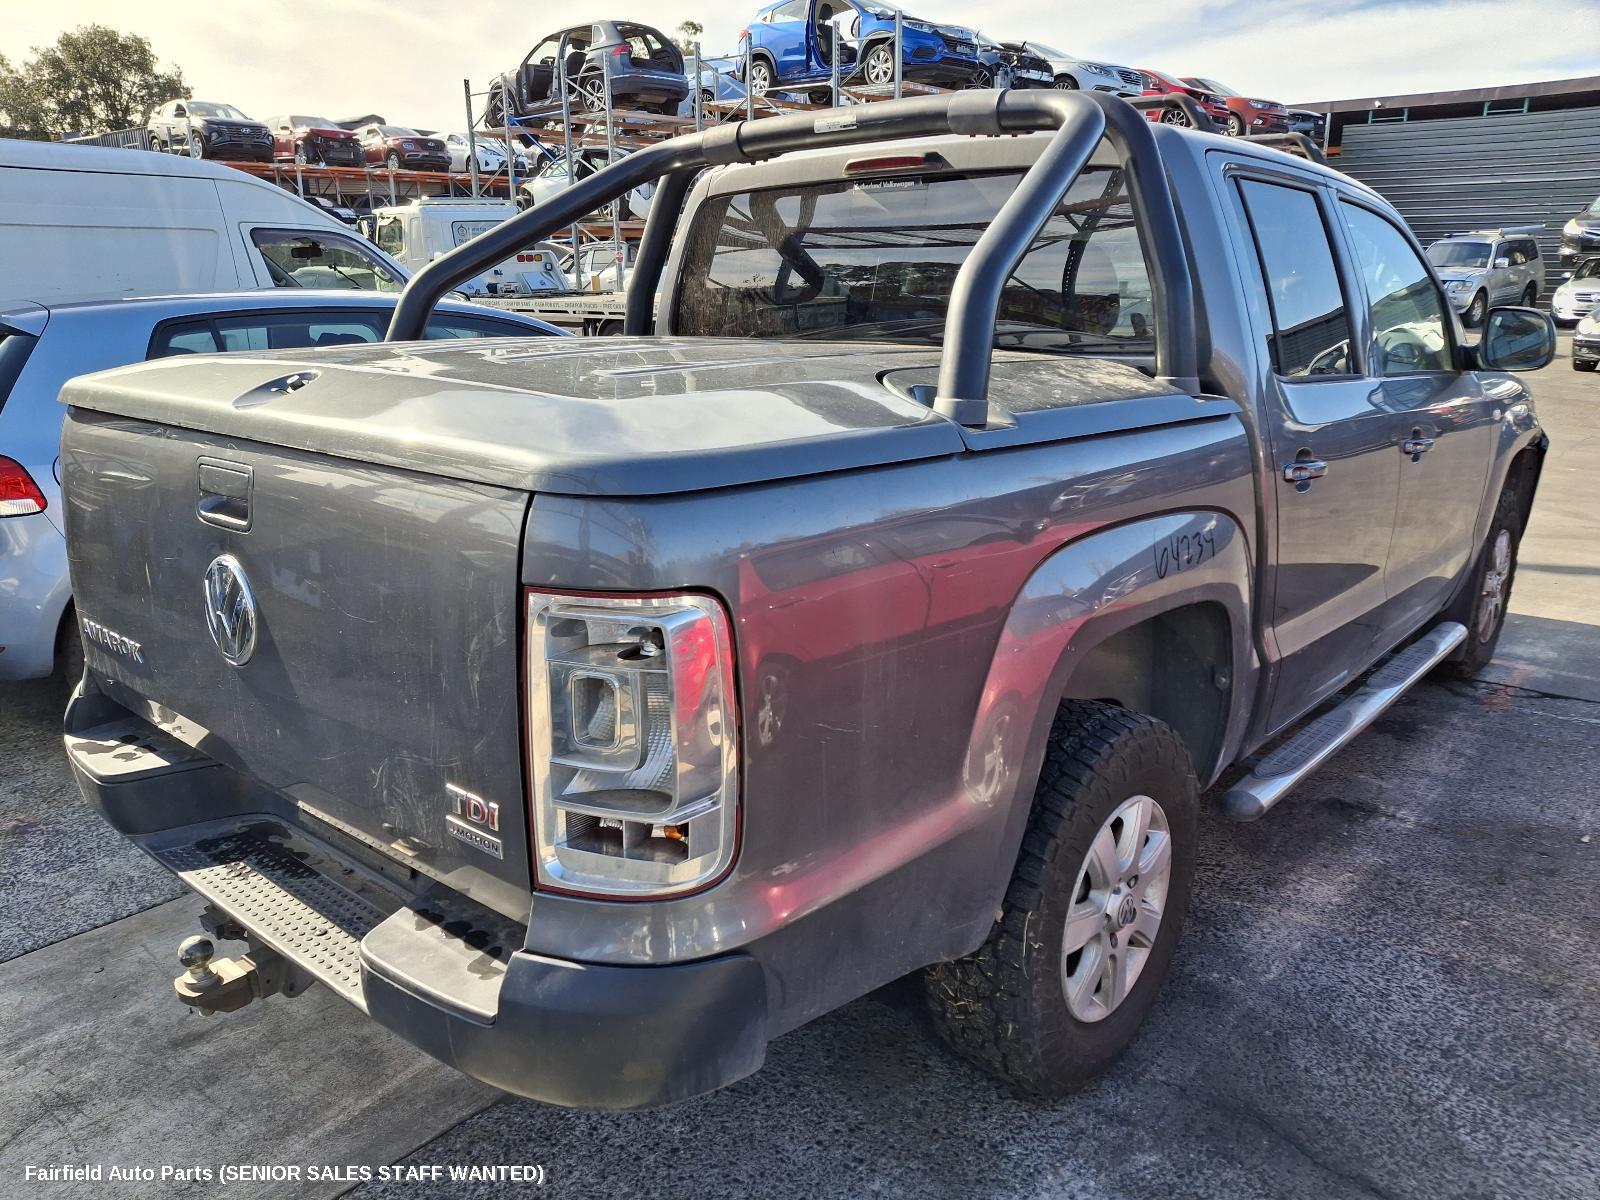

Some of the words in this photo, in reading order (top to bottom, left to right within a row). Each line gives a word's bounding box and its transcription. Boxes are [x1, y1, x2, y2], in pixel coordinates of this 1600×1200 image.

[883, 179, 915, 188] Volkswagen
[83, 617, 144, 664] AMAROK
[445, 783, 499, 831] TDI
